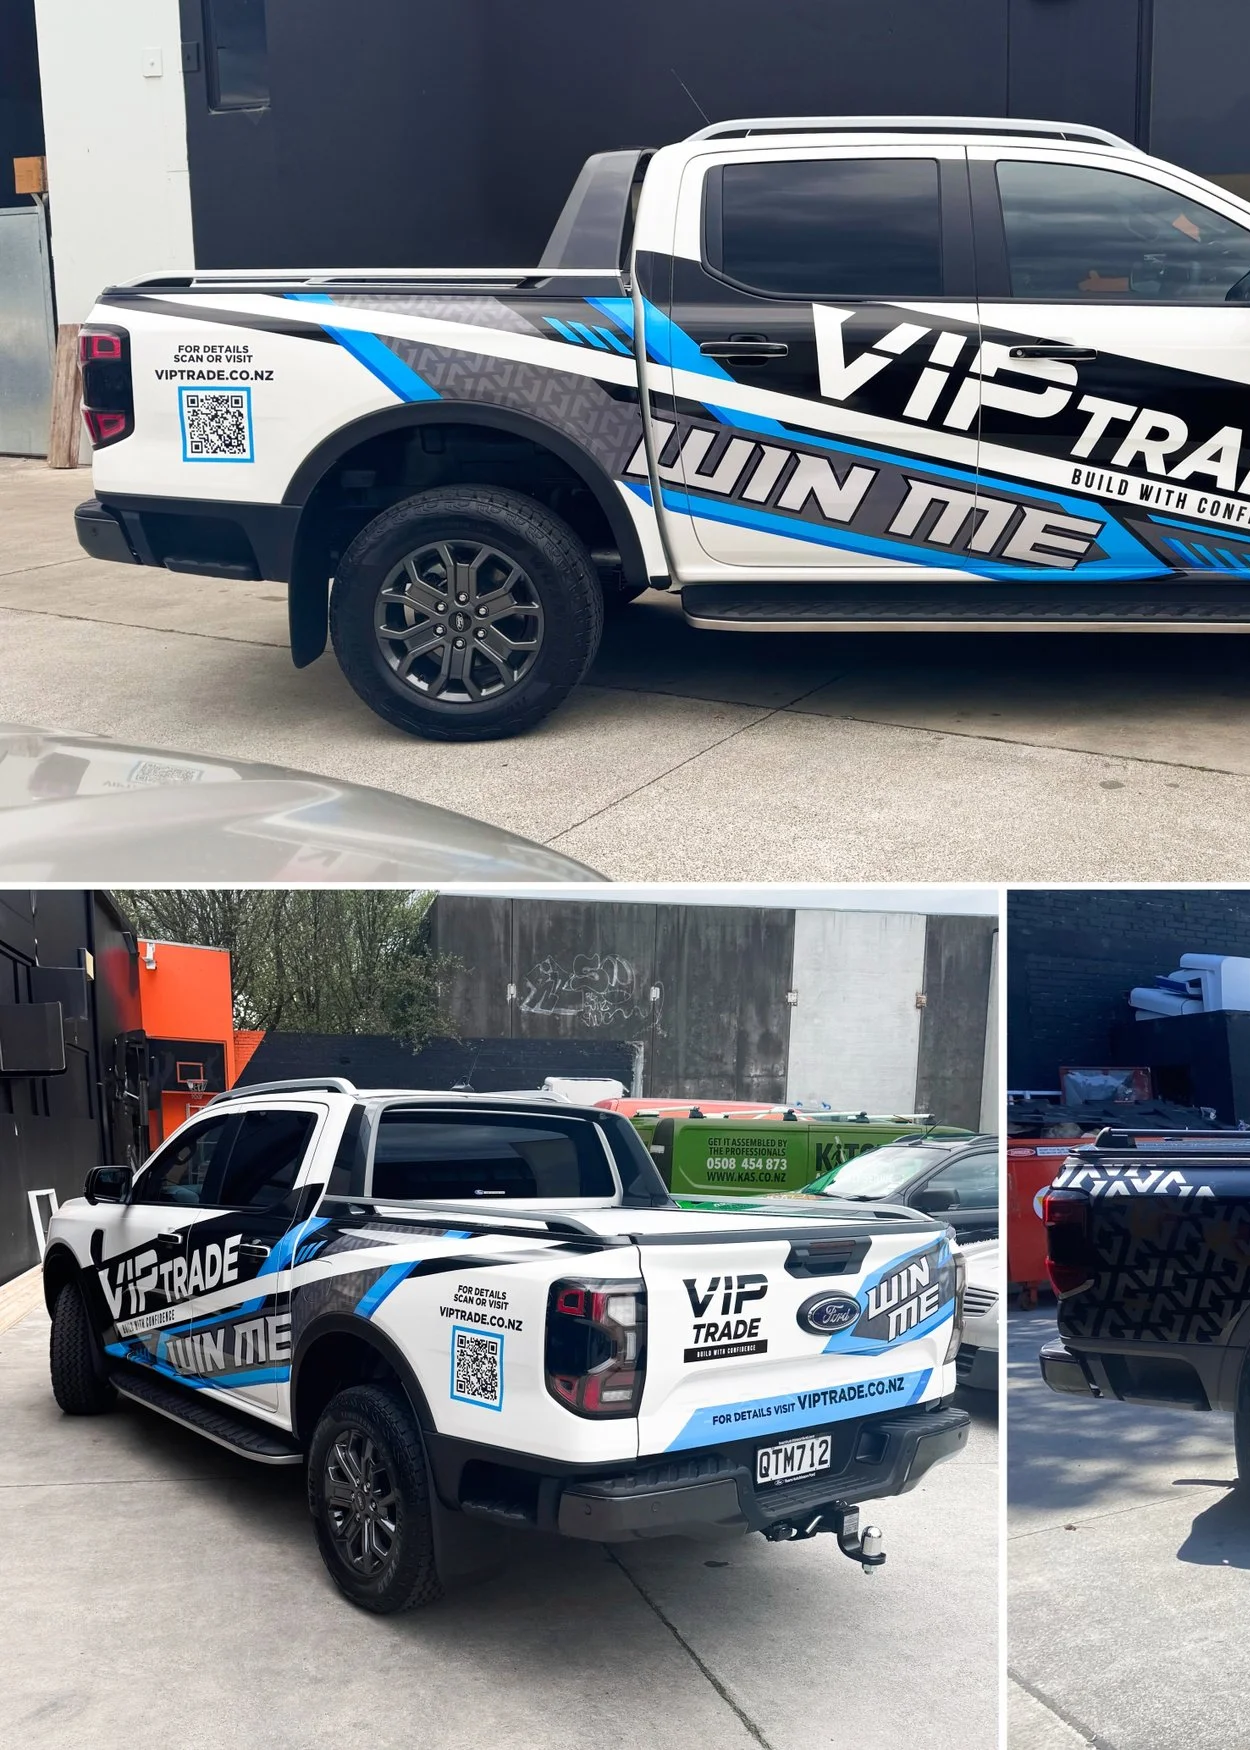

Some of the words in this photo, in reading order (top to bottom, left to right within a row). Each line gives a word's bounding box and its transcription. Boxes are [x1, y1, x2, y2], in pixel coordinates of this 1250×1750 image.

[174, 354, 203, 363] SCAN
[207, 354, 222, 363] OR
[226, 354, 253, 363] VISIT
[178, 345, 201, 354] FOR
[203, 345, 249, 354] DETAILS
[155, 370, 274, 381] VIPTRADE.CO.NZ
[812, 303, 1078, 431] VIP
[622, 416, 879, 525] WIN
[890, 474, 1107, 571] ME
[1071, 468, 1129, 496] BUILD
[1139, 483, 1188, 510] WITH
[708, 1138, 723, 1146] GET
[724, 1138, 730, 1146] IT
[732, 1138, 776, 1147] ASSEMBLED
[778, 1139, 787, 1148] BY
[709, 1147, 724, 1155] THE
[725, 1147, 786, 1156] PROFESSIONALS
[706, 1157, 736, 1169] 0508
[741, 1158, 763, 1170] 454
[766, 1158, 787, 1170] 873
[707, 1171, 786, 1183] WWW.KAS.CO.NZ
[98, 1249, 158, 1319] VIP
[160, 1234, 243, 1303] TRADE
[865, 1255, 931, 1320] WIN
[453, 1294, 474, 1304] SCAN
[475, 1297, 487, 1307] OR
[488, 1299, 509, 1310] VISIT
[458, 1285, 473, 1295] FOR
[474, 1287, 507, 1300] DETAILS
[682, 1273, 768, 1318] VIP
[145, 1309, 175, 1328] CONFIDENCE
[440, 1306, 523, 1331] VIPTRADE.CO.NZ
[822, 1305, 851, 1324] Ford
[887, 1283, 940, 1343] ME
[692, 1318, 761, 1344] TRADE
[166, 1328, 225, 1375] WIN
[233, 1312, 292, 1368] ME
[697, 1349, 711, 1358] BUILD
[713, 1348, 726, 1356] WITH
[727, 1344, 756, 1354] CONFIDENCE
[712, 1413, 732, 1425] FOR
[734, 1407, 772, 1423] DETAILS
[774, 1402, 796, 1416] VISIT
[797, 1377, 905, 1411] VIPTRADE.CO.NZ
[759, 1439, 830, 1479] QTM712
